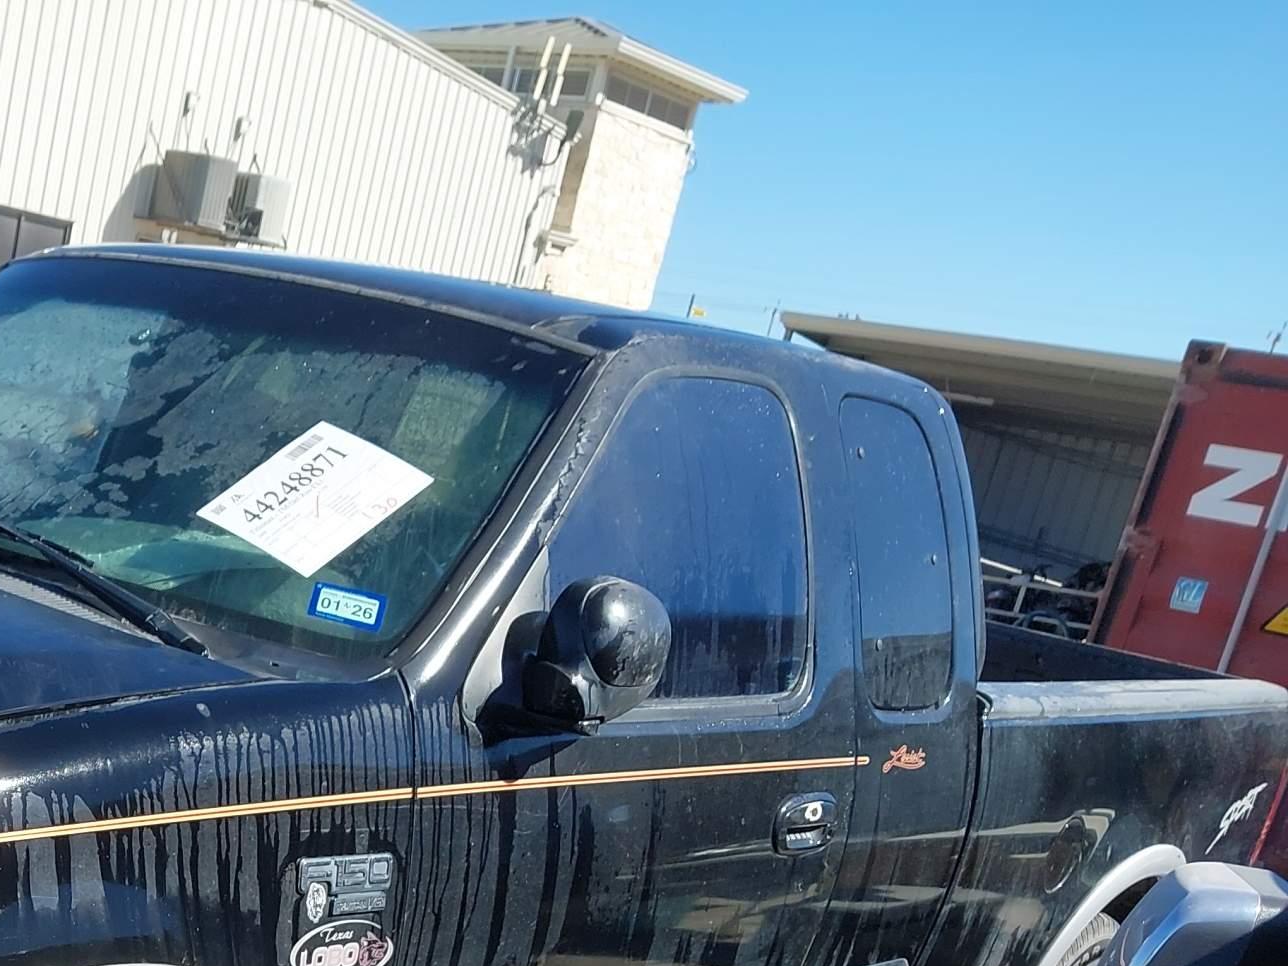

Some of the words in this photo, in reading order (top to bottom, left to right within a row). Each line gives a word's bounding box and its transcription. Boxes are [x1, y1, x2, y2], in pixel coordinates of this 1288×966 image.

[243, 446, 348, 523] 44248871
[320, 597, 341, 612] 01
[351, 604, 374, 620] 26
[320, 927, 355, 943] Texas
